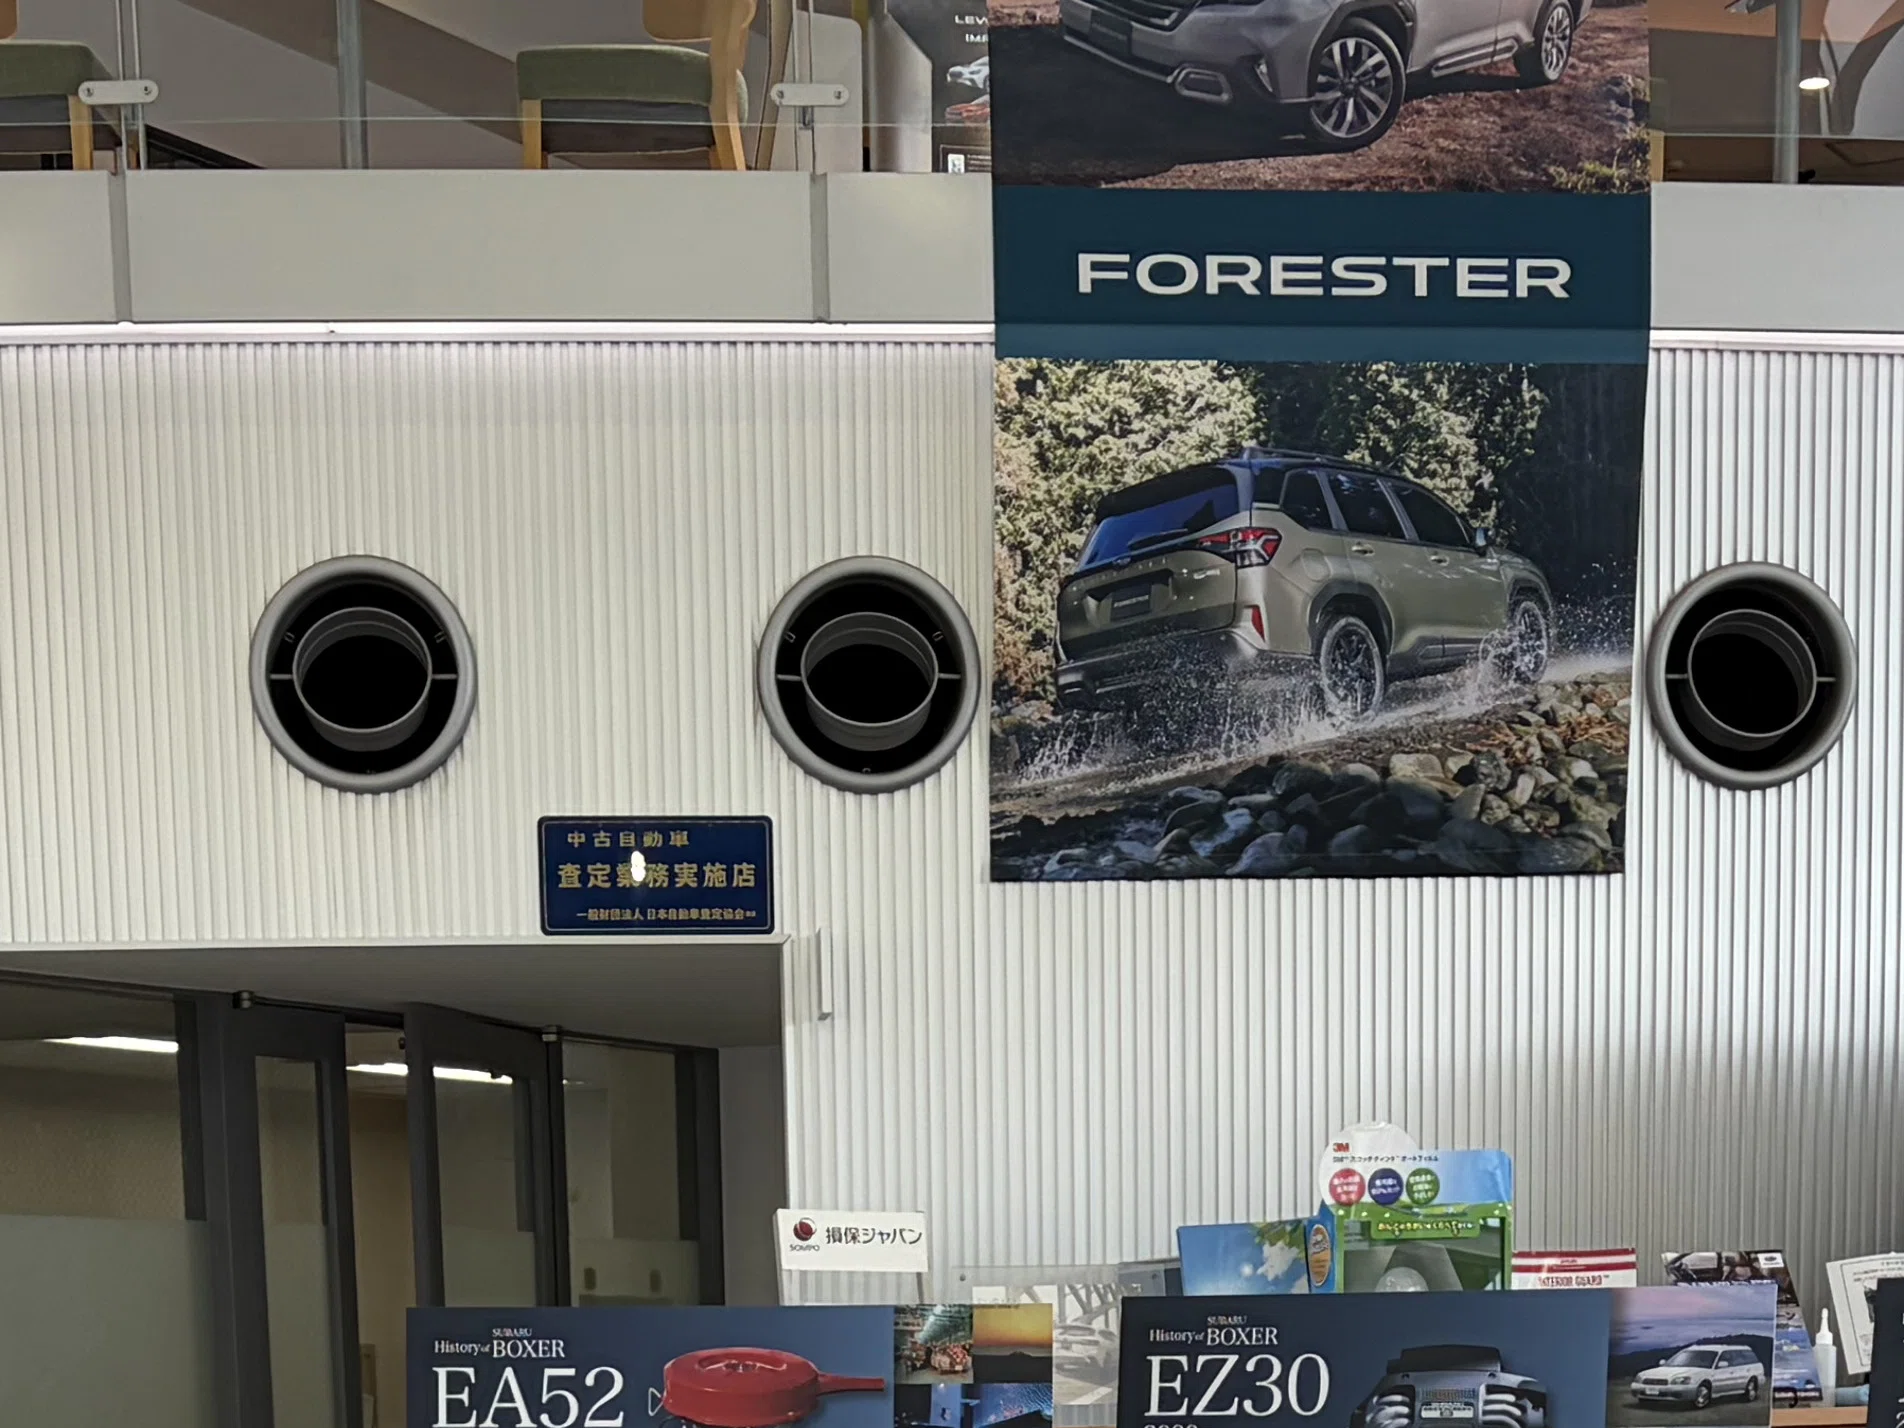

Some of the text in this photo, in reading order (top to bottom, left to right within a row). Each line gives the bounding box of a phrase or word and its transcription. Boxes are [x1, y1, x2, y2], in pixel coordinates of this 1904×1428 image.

[1077, 252, 1572, 299] FORESTER
[567, 830, 690, 848] 中古自動車
[1333, 1142, 1350, 1153] 3M
[825, 1226, 923, 1245] 損保ジャパン
[1149, 1326, 1278, 1346] History of BOXER
[434, 1339, 566, 1358] History of BOXER
[1144, 1353, 1330, 1417] EZ30
[432, 1366, 624, 1428] EA52
